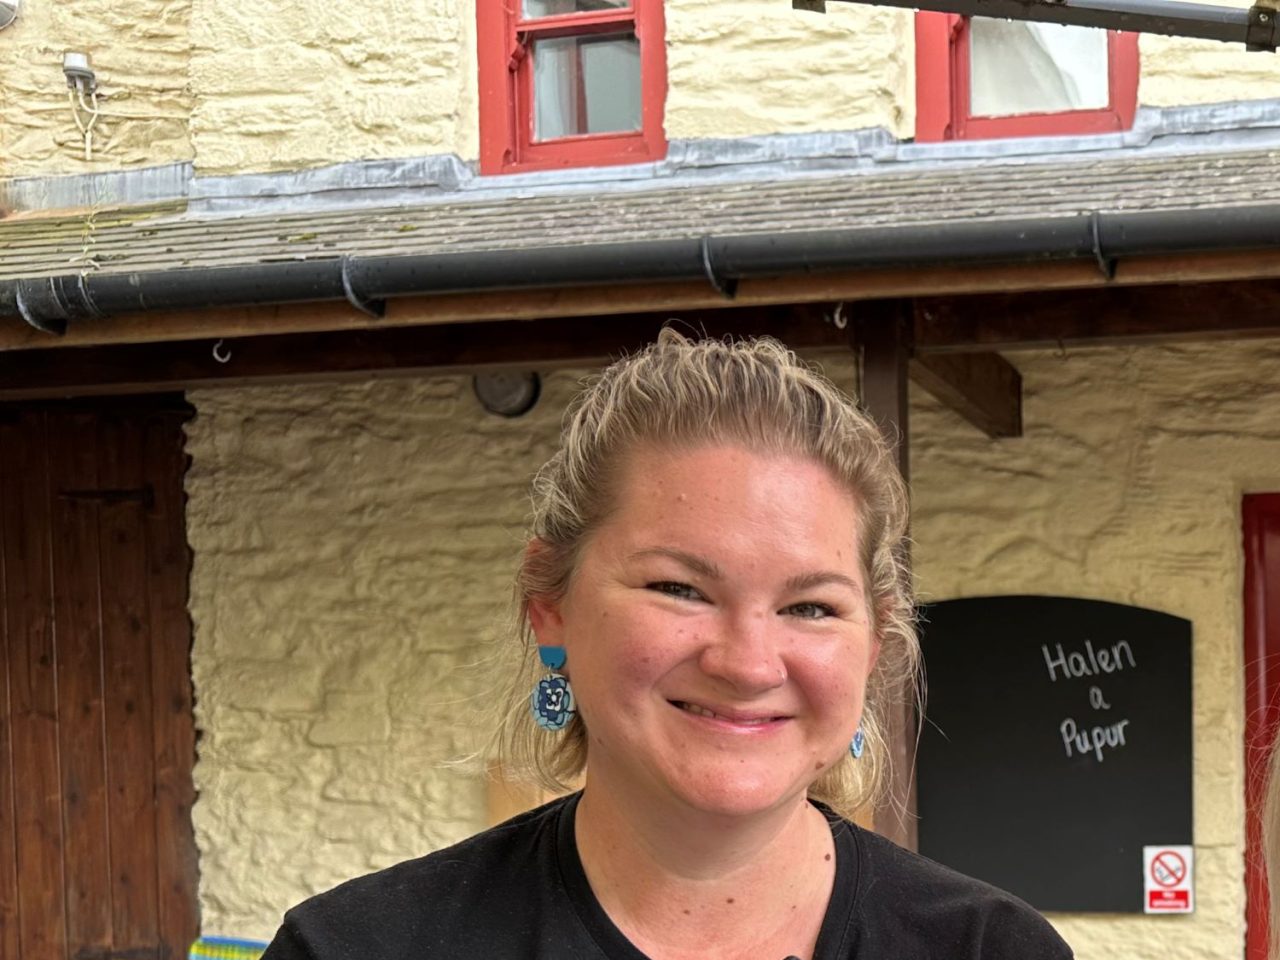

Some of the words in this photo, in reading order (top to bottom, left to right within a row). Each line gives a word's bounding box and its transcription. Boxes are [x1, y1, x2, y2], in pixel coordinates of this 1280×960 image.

[1042, 640, 1136, 682] Halen
[1089, 686, 1111, 710] a
[1060, 717, 1129, 762] Pupur
